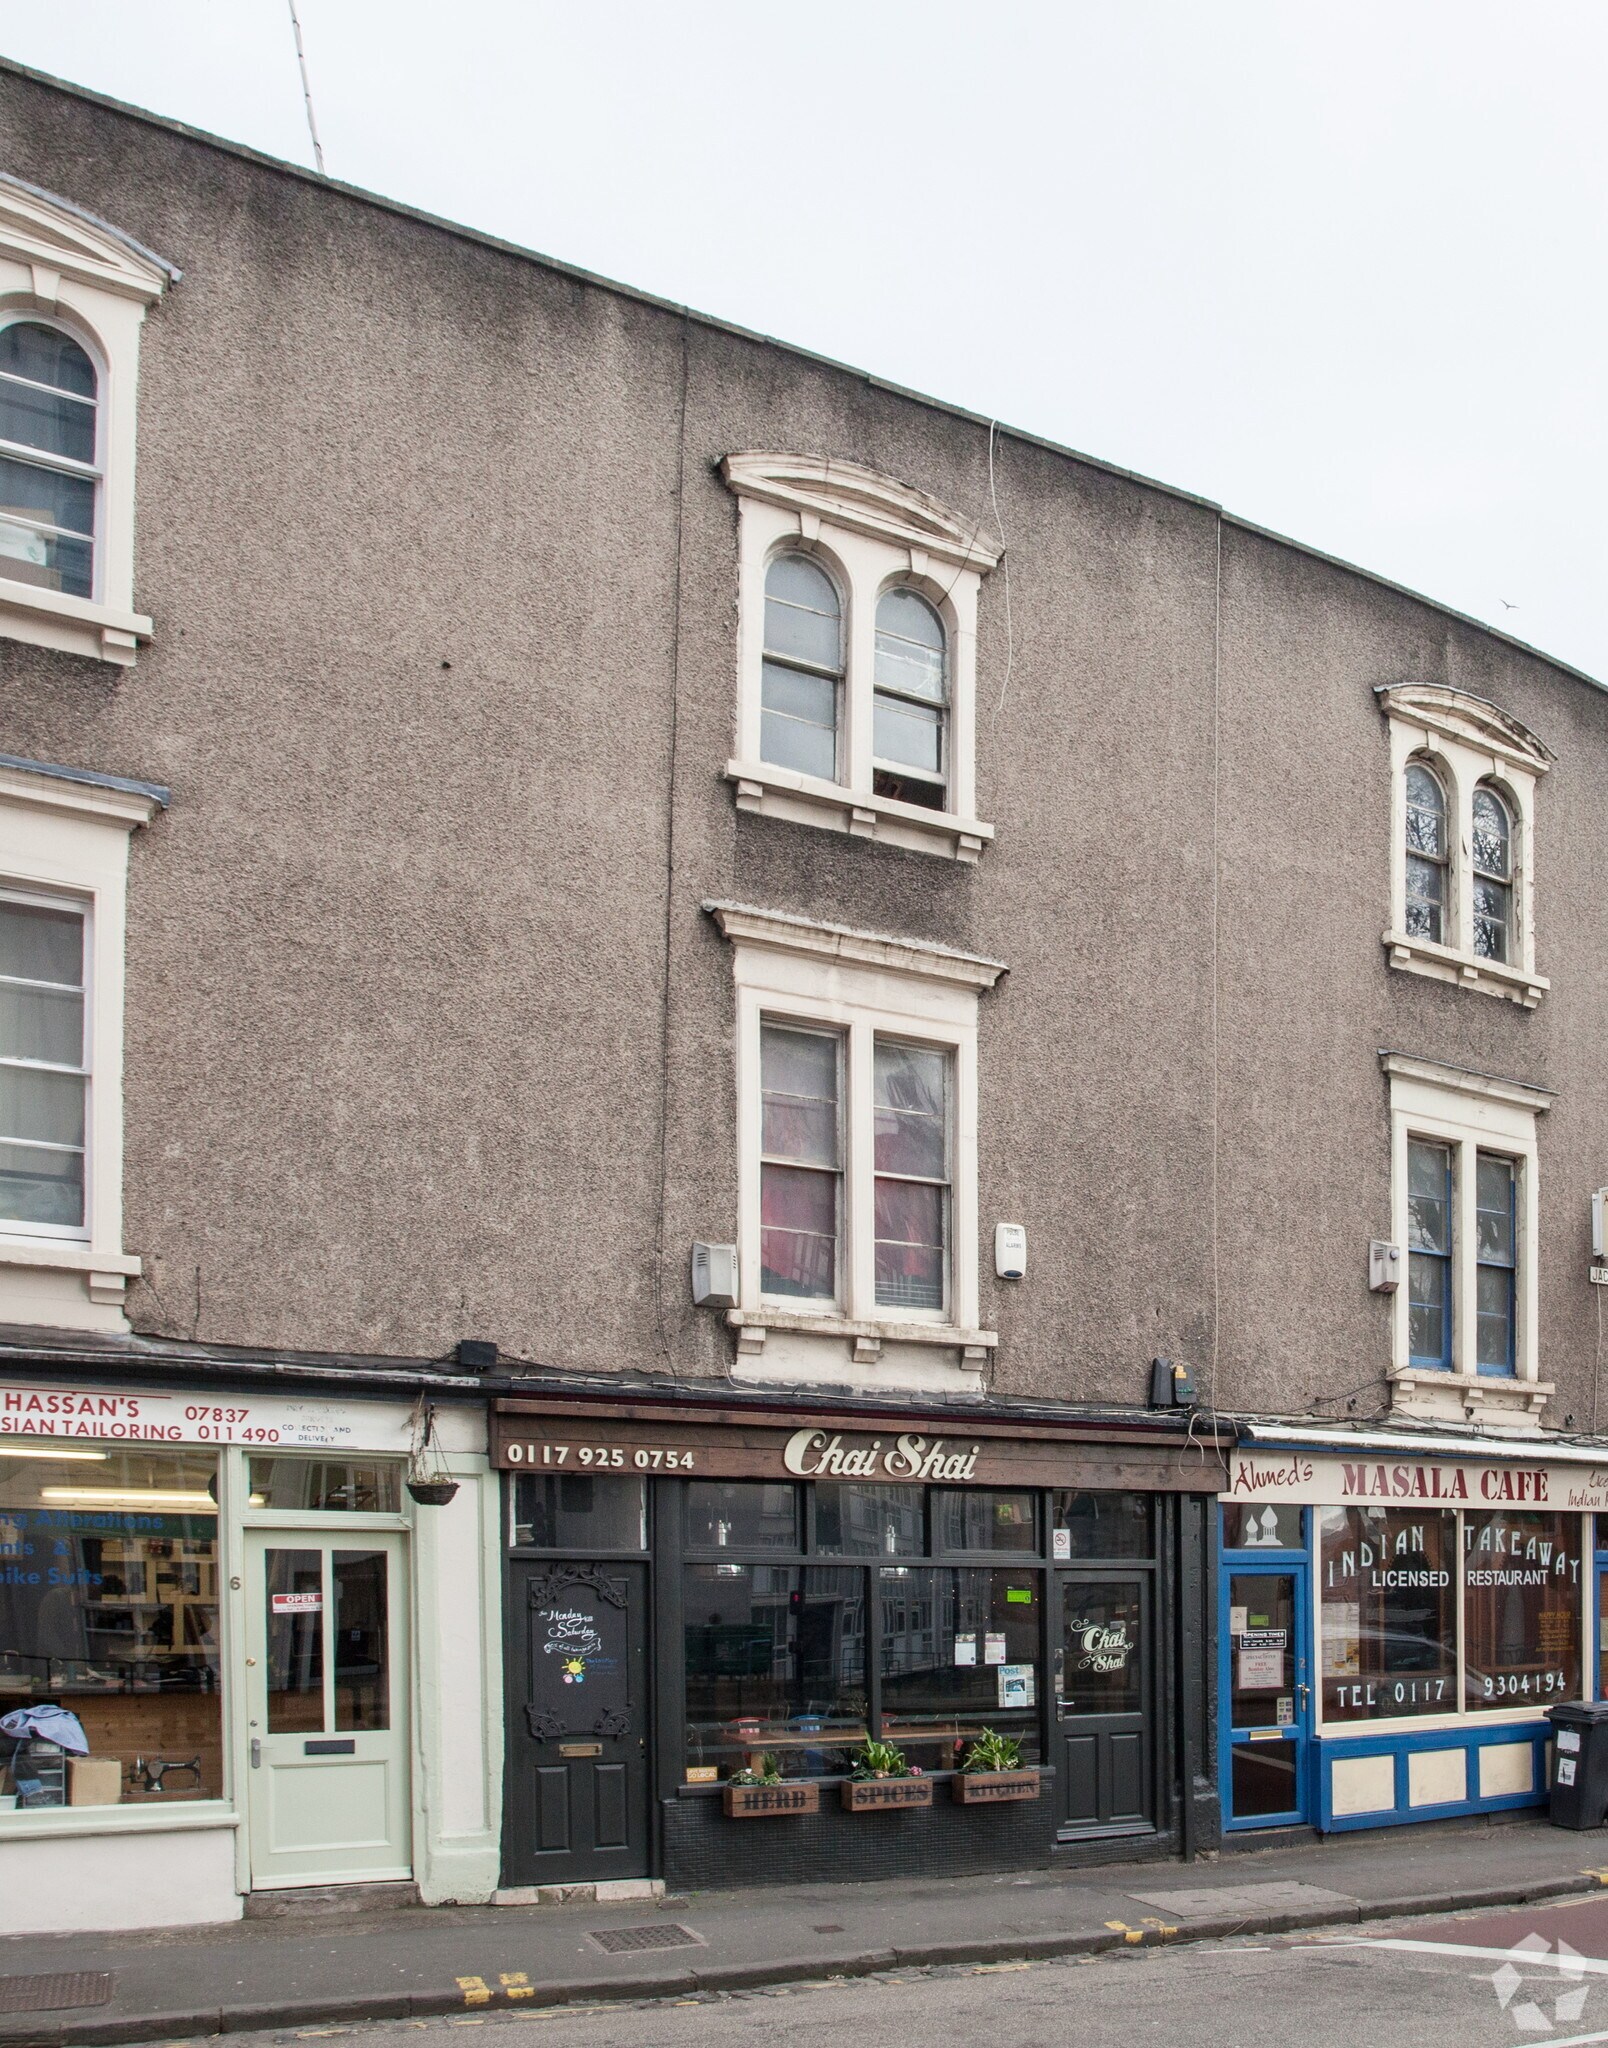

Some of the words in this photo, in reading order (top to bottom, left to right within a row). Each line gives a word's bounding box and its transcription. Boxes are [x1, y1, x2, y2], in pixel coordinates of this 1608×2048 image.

[5, 1393, 139, 1418] HASSAN'S
[185, 1406, 249, 1423] 07837
[62, 1420, 182, 1440] TAILORING
[198, 1425, 232, 1440] 011
[242, 1428, 279, 1442] 490
[508, 1444, 569, 1465] 0117
[578, 1447, 624, 1467] 925
[634, 1450, 694, 1469] 0754
[784, 1428, 881, 1476] Chai
[884, 1434, 980, 1480] Shai
[1234, 1456, 1313, 1495] Ahmed's
[1341, 1463, 1469, 1499] MASALA
[1480, 1468, 1549, 1502] CAFÉ
[1568, 1488, 1601, 1508] Indian
[34, 1510, 165, 1530] Alterations
[1329, 1525, 1424, 1587] INDIAN
[1464, 1525, 1580, 1584] TAKEAWAY
[47, 1567, 104, 1585] Suits
[229, 1576, 241, 1591] 6
[1372, 1571, 1449, 1587] LICENSED
[1467, 1569, 1549, 1586] RESTAURANT
[286, 1595, 316, 1604] OPEN
[1082, 1626, 1127, 1650] Chai
[1000, 1666, 1019, 1675] Post
[1093, 1654, 1126, 1672] Shai
[1337, 1684, 1376, 1707] TEL
[1395, 1679, 1445, 1702] 0117
[1484, 1672, 1566, 1696] 9304194
[855, 1784, 929, 1804] SPICES
[968, 1780, 1036, 1797] KITCHEN
